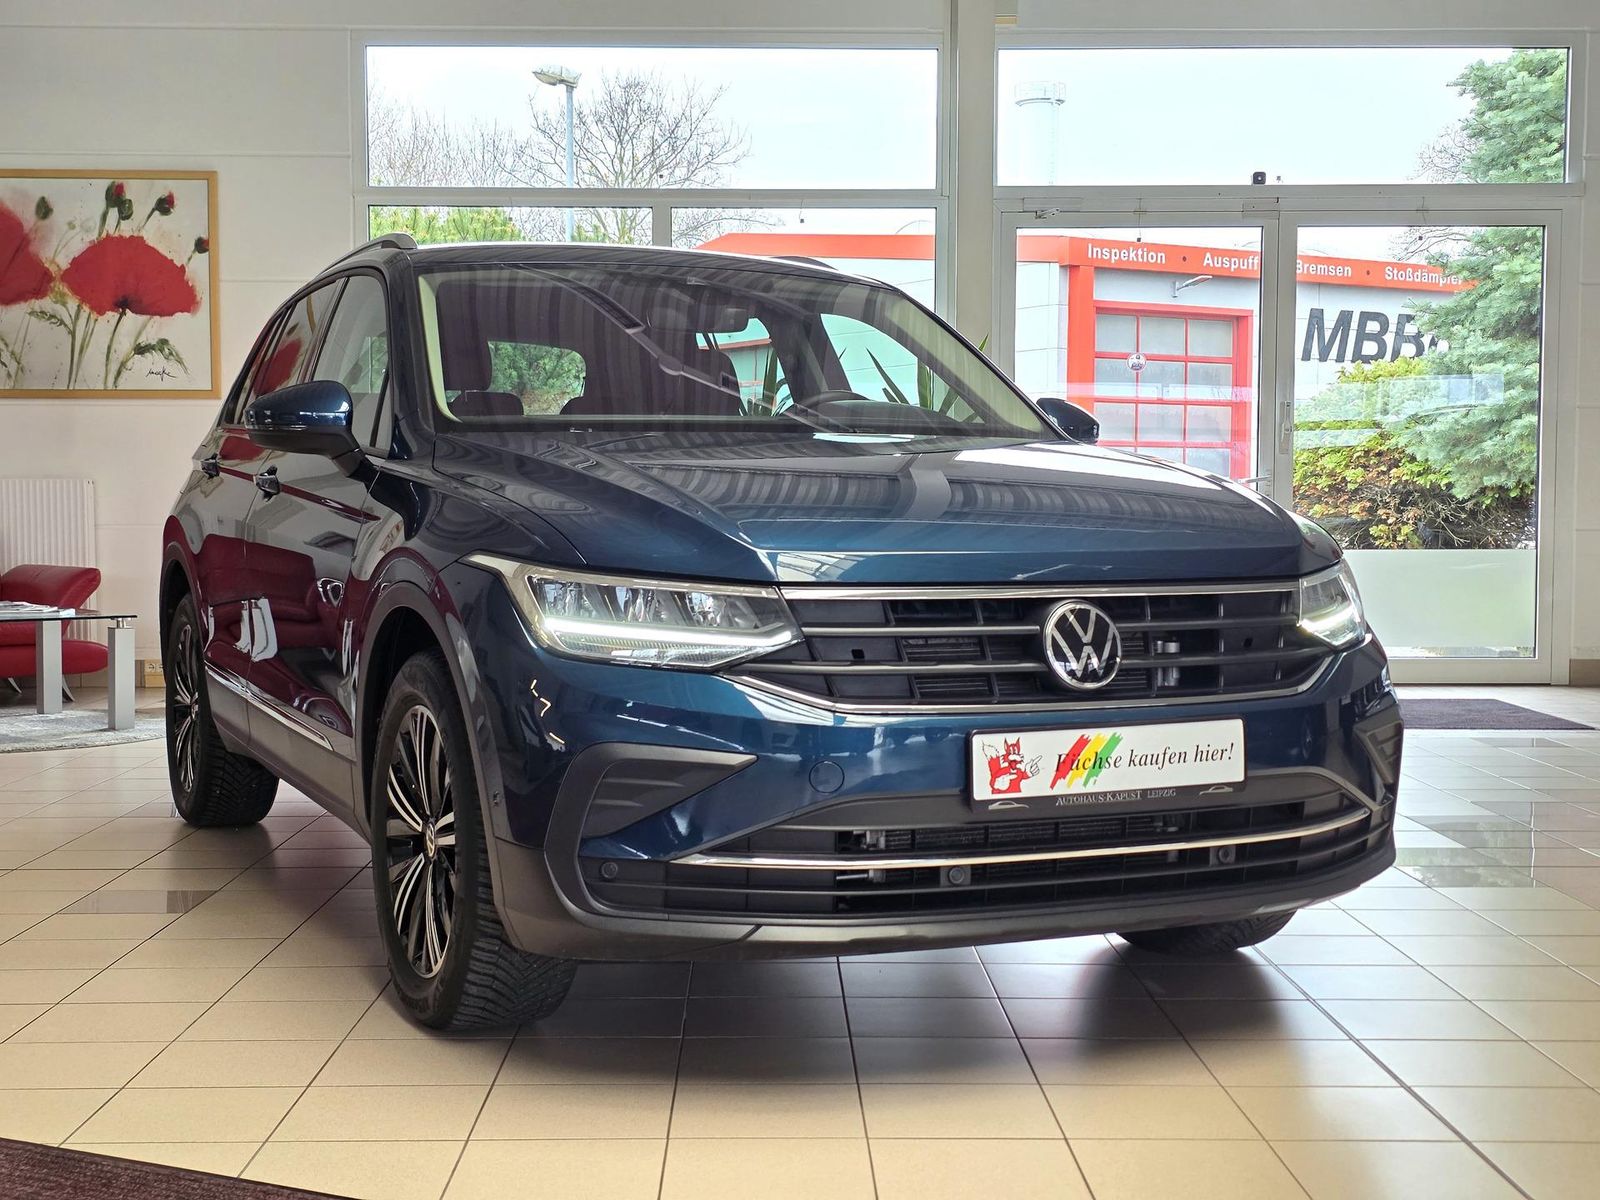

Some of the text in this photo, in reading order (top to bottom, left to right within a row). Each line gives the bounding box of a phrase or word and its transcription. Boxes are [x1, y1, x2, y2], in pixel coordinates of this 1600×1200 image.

[1087, 243, 1166, 265] Inspektion
[1203, 252, 1259, 272] Auspuff
[1296, 259, 1352, 277] Bremsen
[1301, 308, 1451, 364] MBB
[1048, 606, 1117, 681] VW
[1055, 743, 1235, 772] Füchse kaufen hier!
